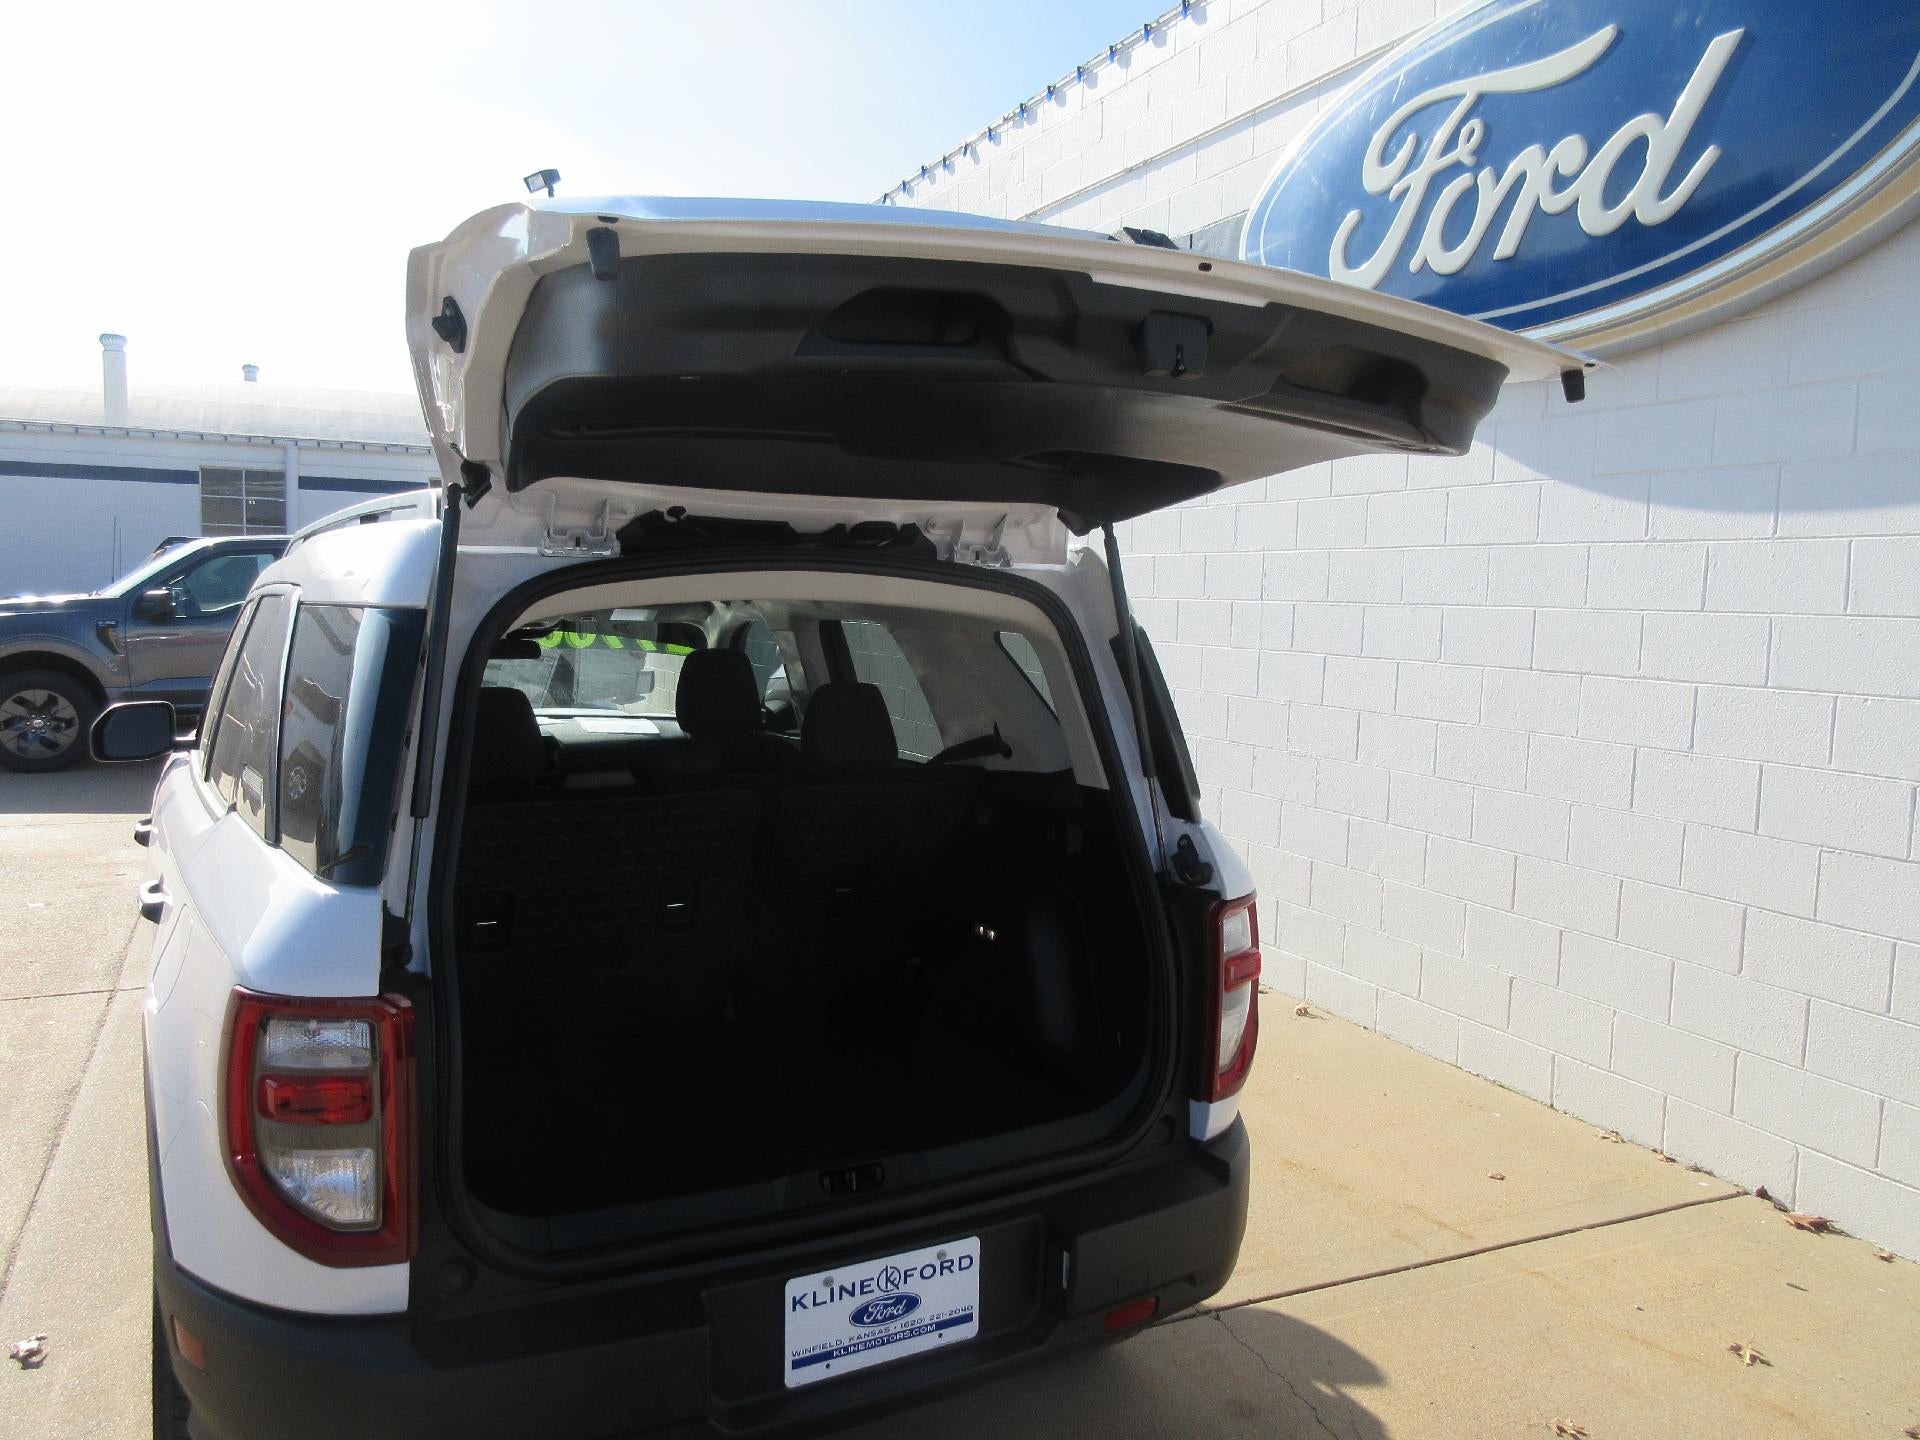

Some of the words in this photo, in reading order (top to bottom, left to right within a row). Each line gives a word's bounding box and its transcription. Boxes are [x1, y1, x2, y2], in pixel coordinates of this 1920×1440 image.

[1329, 23, 1745, 289] Ford
[792, 1277, 875, 1312] KLINE
[903, 1254, 974, 1284] FORD
[791, 1339, 845, 1358] WINFIELD,
[849, 1327, 891, 1342] KANSAS
[929, 1305, 974, 1321] 221-2040
[863, 1298, 907, 1323] Ford
[832, 1323, 937, 1358] KLINEMOTORS.COM
